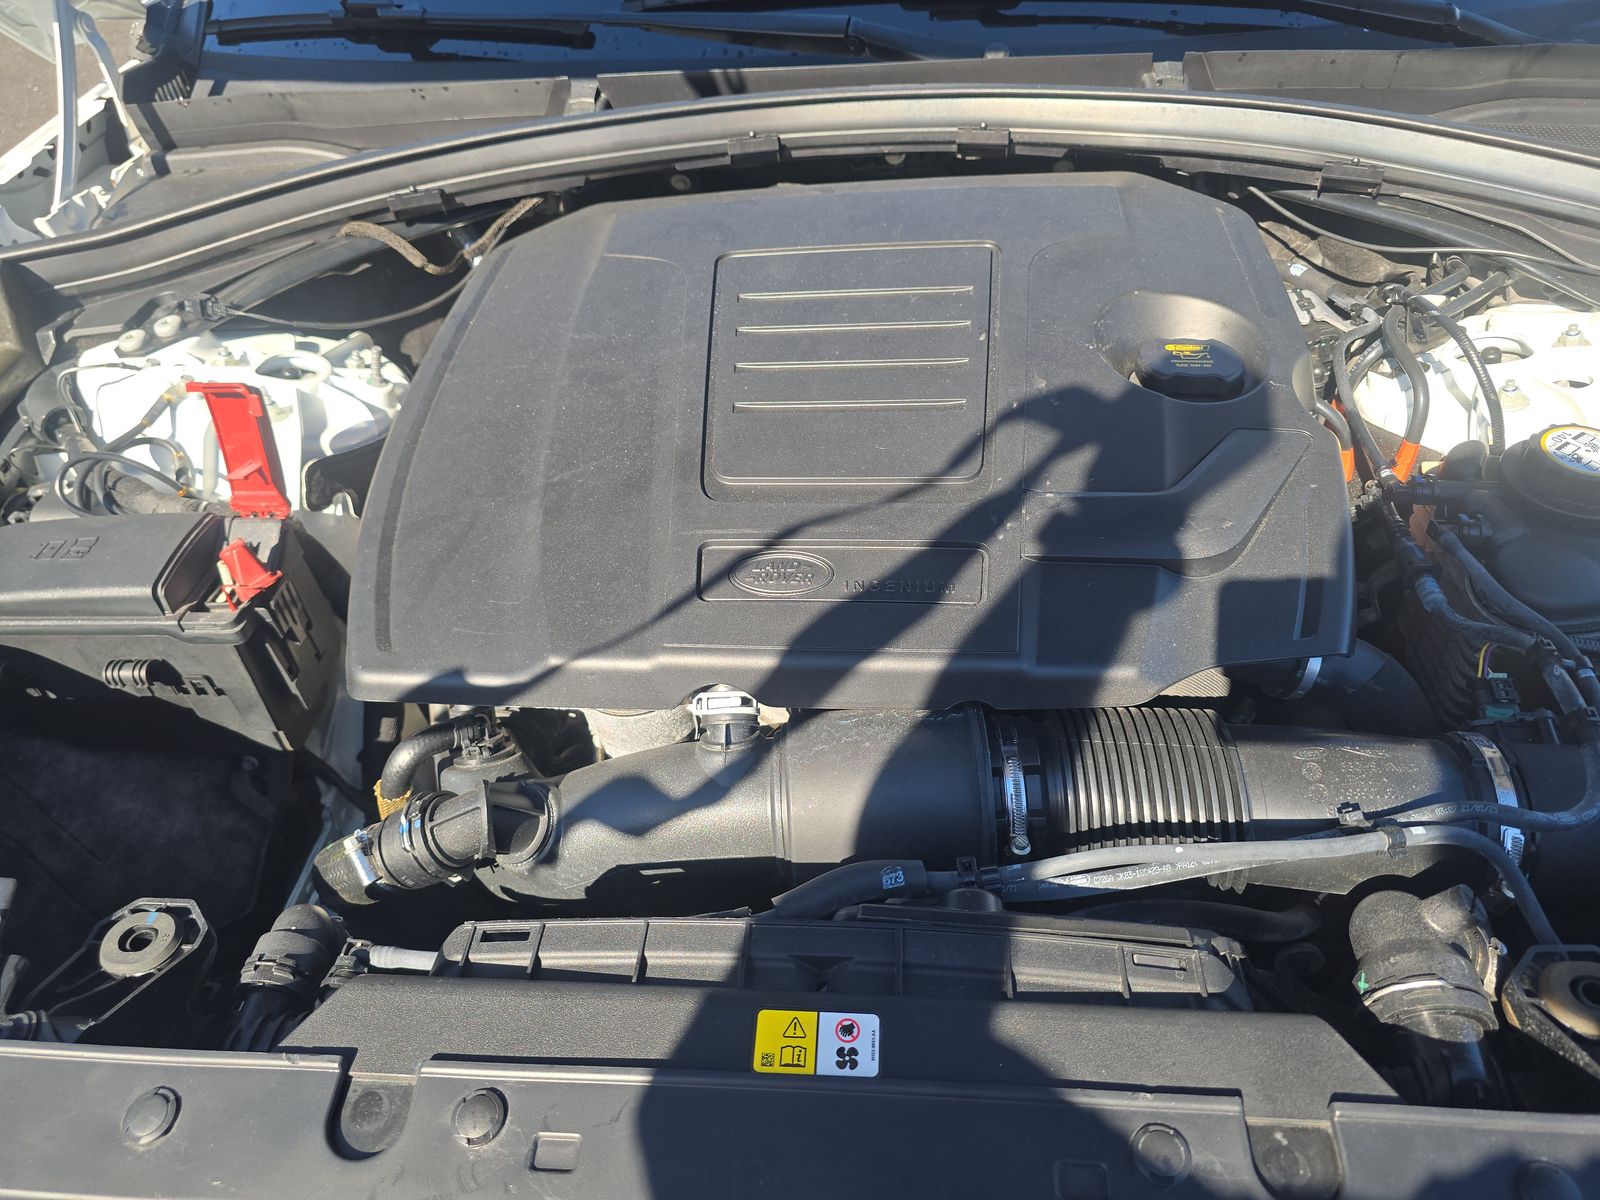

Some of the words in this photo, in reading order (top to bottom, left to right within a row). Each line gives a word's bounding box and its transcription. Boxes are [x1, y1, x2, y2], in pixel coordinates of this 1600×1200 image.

[752, 561, 801, 572] LAND
[754, 573, 815, 584] ROVER
[843, 579, 957, 594] INGENIUM
